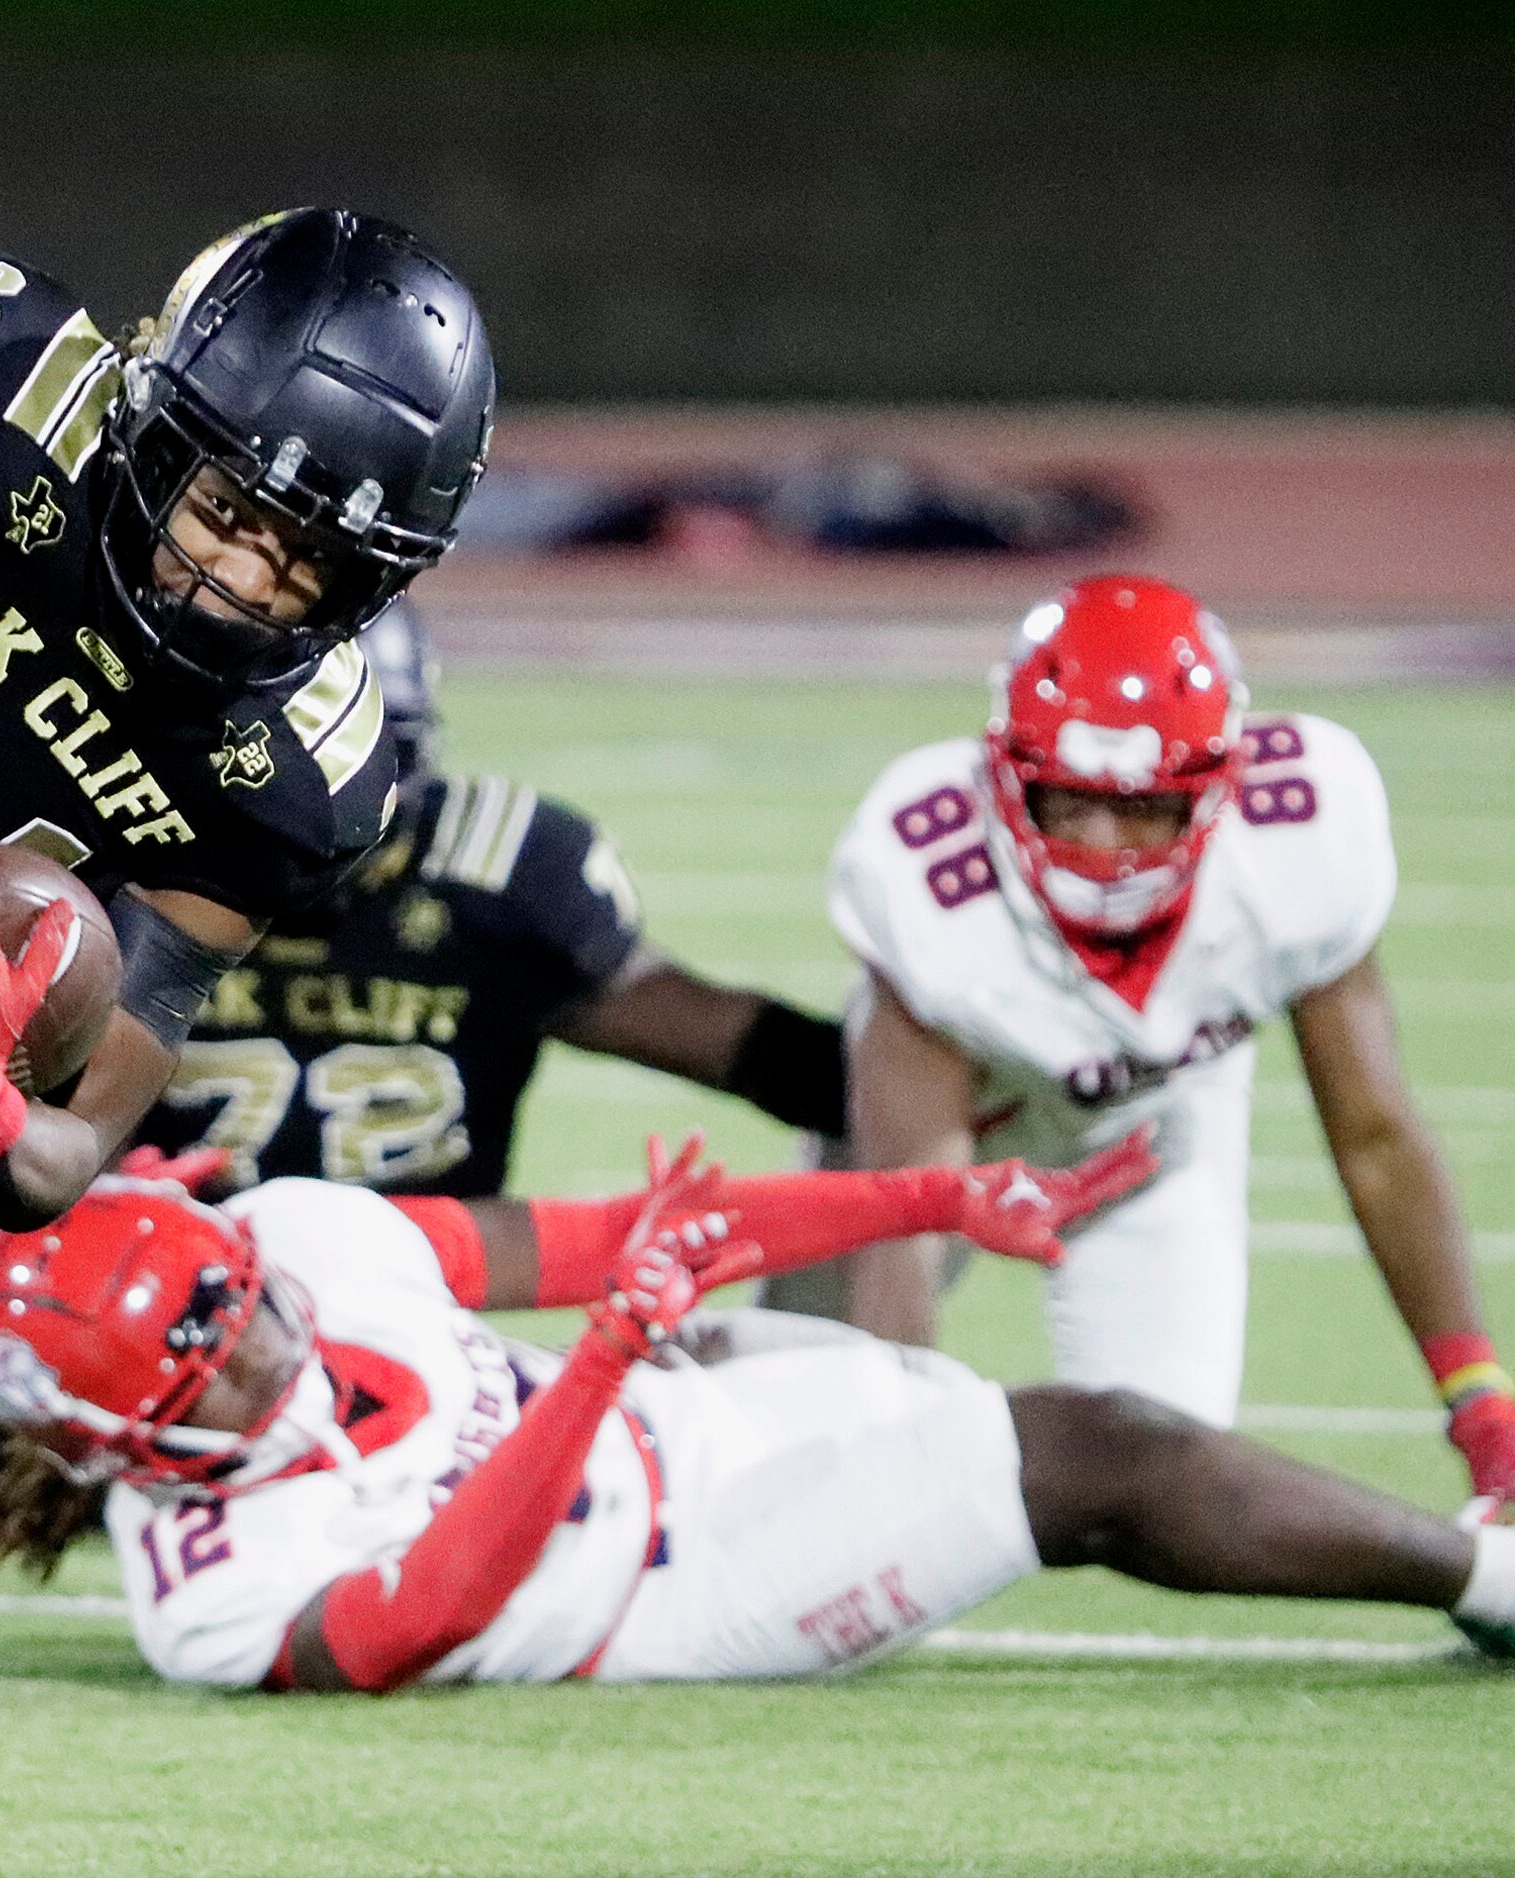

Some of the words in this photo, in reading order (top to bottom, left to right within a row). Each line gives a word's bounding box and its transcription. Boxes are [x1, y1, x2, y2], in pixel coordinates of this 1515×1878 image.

[24, 677, 197, 845] CLIFF
[236, 741, 267, 777] 22
[892, 786, 1002, 910] 88
[162, 1037, 472, 1188] 72
[141, 1496, 232, 1606] 12
